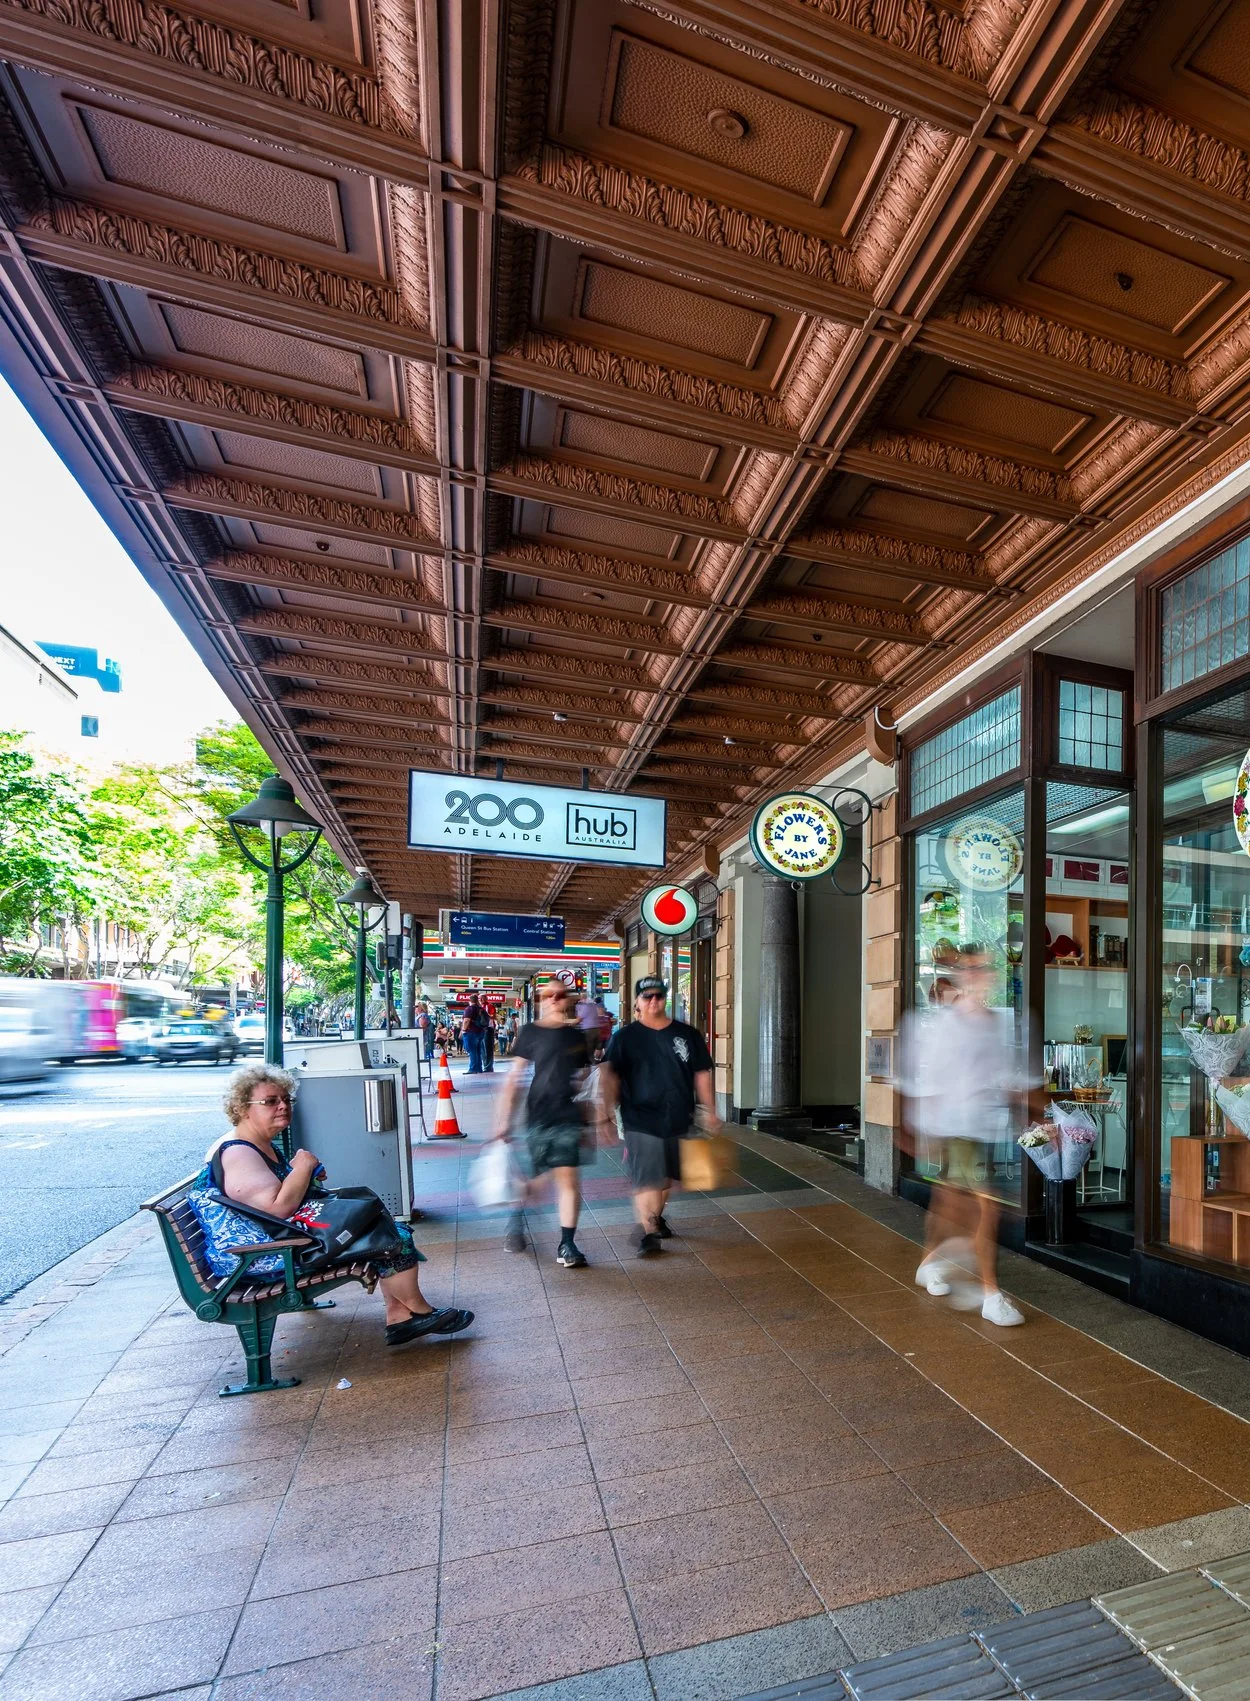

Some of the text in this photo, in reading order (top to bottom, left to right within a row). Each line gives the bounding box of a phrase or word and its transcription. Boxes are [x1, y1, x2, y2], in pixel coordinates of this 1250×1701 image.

[444, 790, 545, 830] 200
[444, 826, 542, 843] ADELAIDE
[575, 809, 628, 838] hub
[774, 813, 827, 845] FLOWERS
[575, 836, 627, 845] AUSTRALIA
[785, 848, 817, 859] JANE
